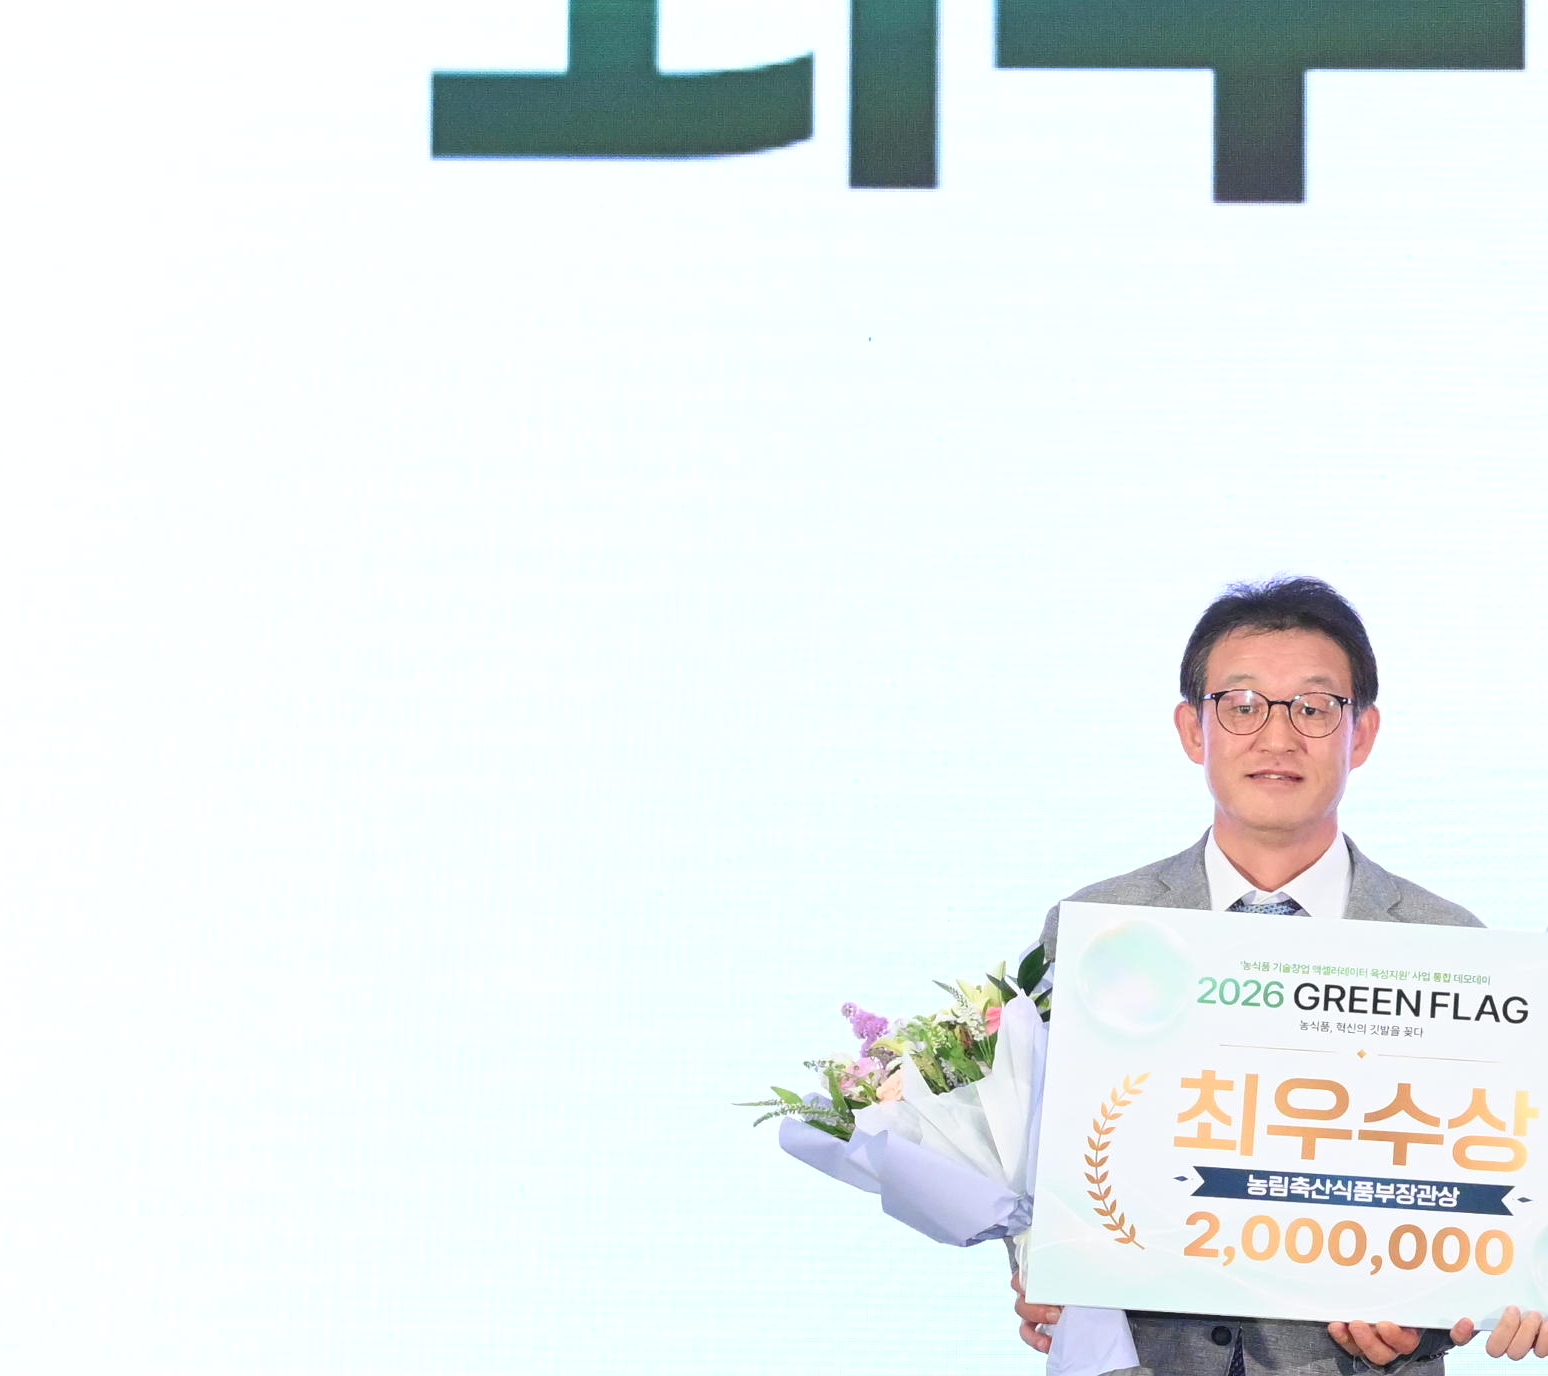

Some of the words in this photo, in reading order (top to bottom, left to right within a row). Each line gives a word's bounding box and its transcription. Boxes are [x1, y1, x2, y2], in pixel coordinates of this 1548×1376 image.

[1274, 961, 1310, 975] 기술창업
[1197, 977, 1284, 1008] 2026
[1294, 983, 1421, 1017] GREEN
[1430, 992, 1528, 1024] FLAG
[1174, 1070, 1538, 1172] 최우수상
[1246, 1174, 1460, 1207] 농림축산식품부장관상
[1184, 1210, 1514, 1275] 2,000,000
